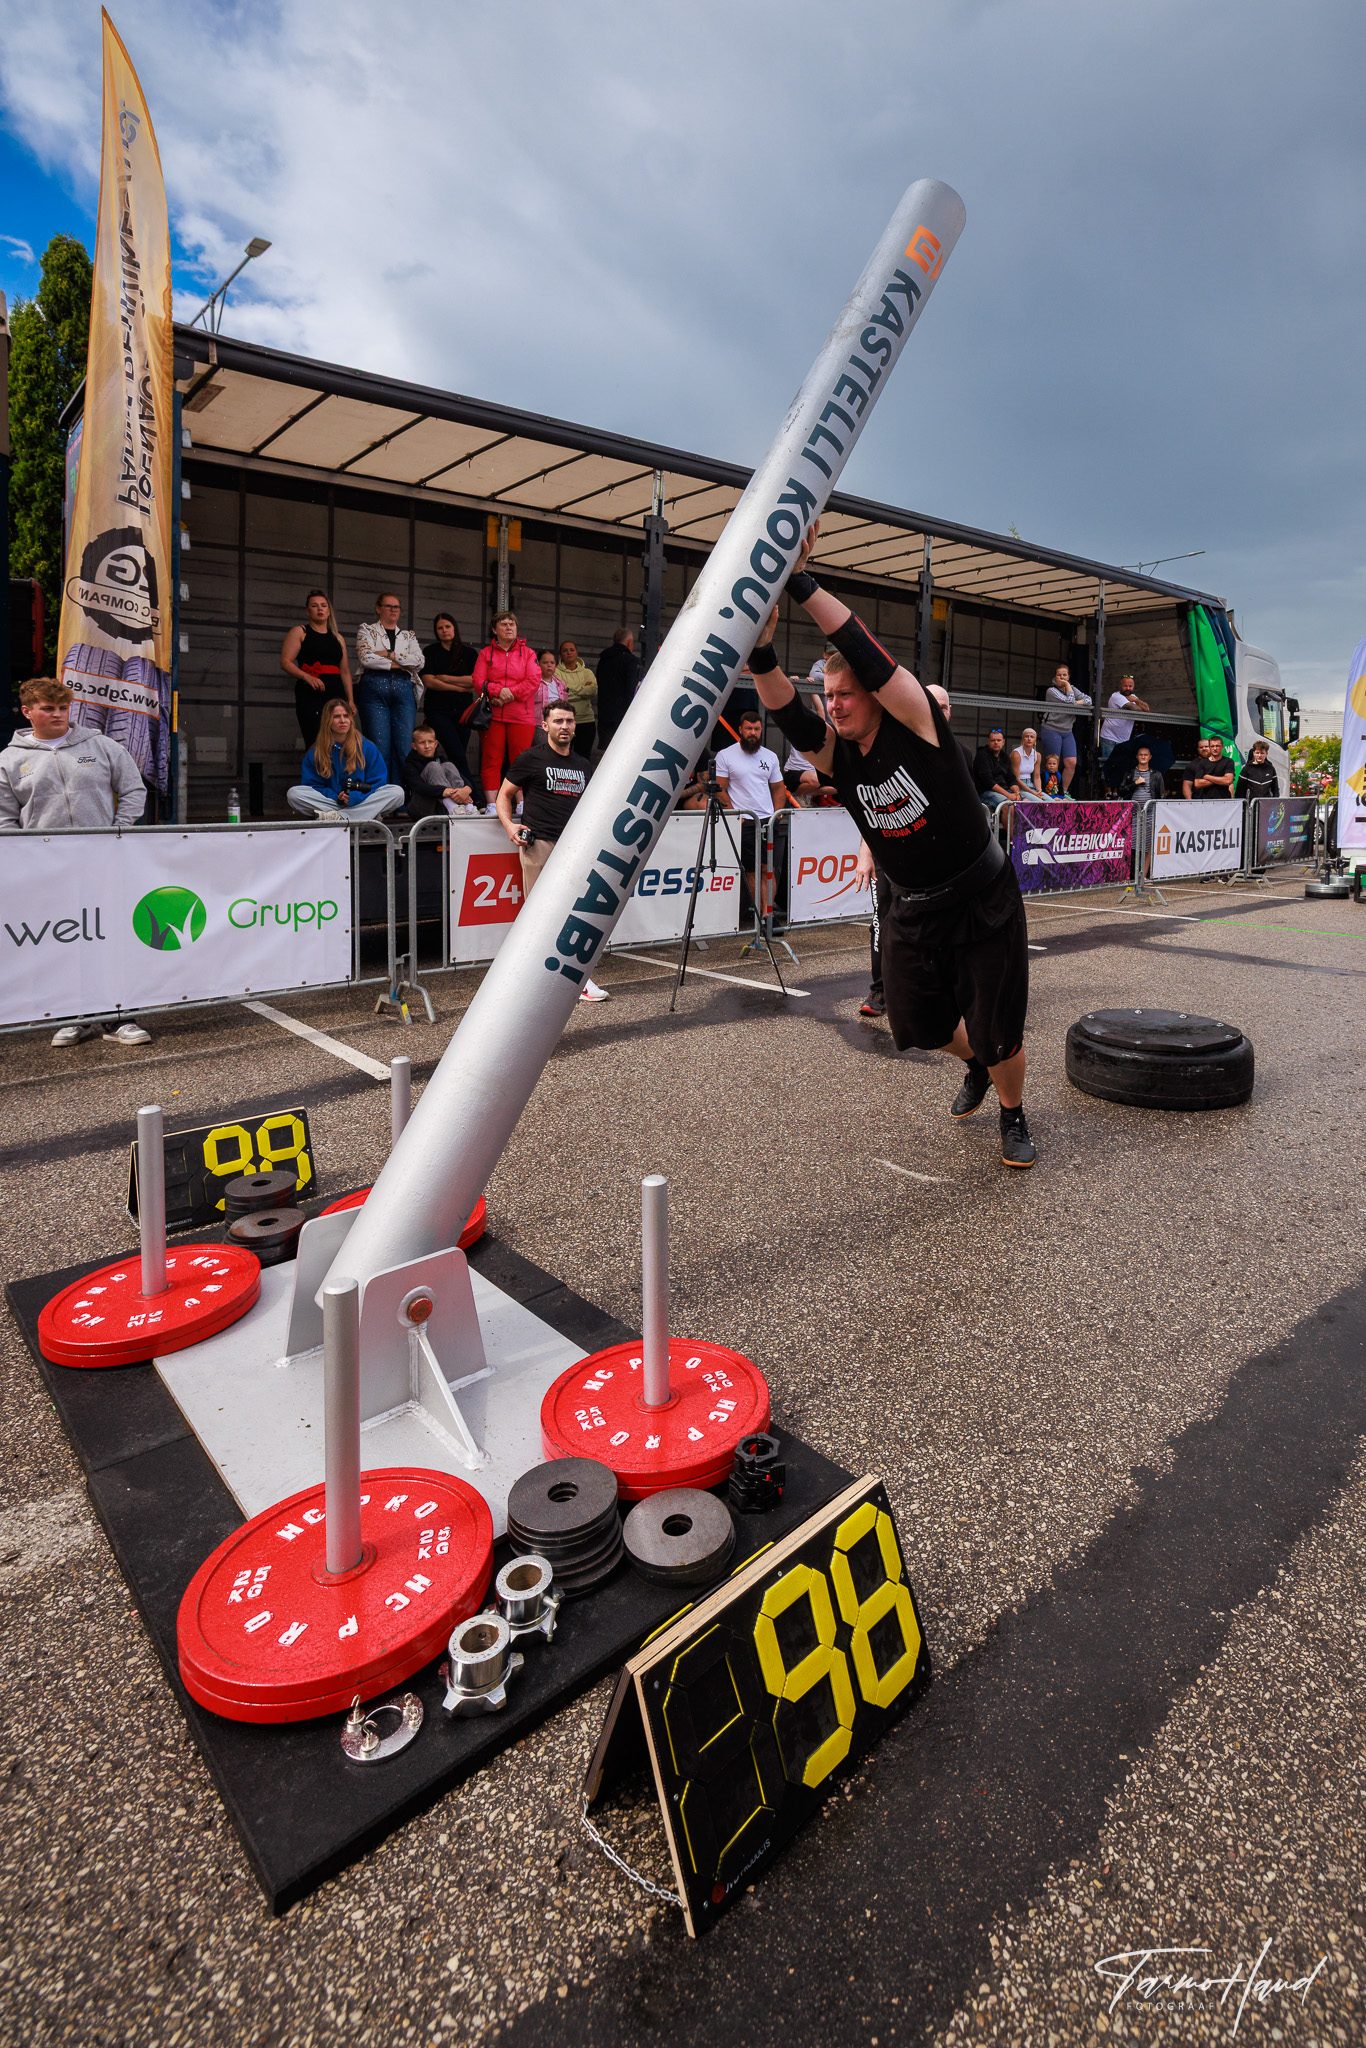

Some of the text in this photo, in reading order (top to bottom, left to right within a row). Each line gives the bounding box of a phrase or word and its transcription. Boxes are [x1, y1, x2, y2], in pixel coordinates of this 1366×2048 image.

[801, 268, 921, 479] KASTELLI
[670, 633, 740, 739] MIS
[1053, 832, 1125, 852] KLEEBIKUM.EE
[1175, 827, 1239, 854] KASTELLI
[545, 739, 689, 985] KESTAB!
[629, 867, 734, 897] ess.ee
[4, 898, 338, 947] well Grupp
[629, 1356, 701, 1370] PO
[702, 1370, 727, 1383] 25
[709, 1379, 734, 1392] KG
[574, 1406, 602, 1421] 25
[580, 1416, 607, 1432] KG
[419, 1526, 451, 1545] 25
[417, 1541, 450, 1560] KG
[233, 1565, 272, 1588] 25
[227, 1584, 264, 1605] KG
